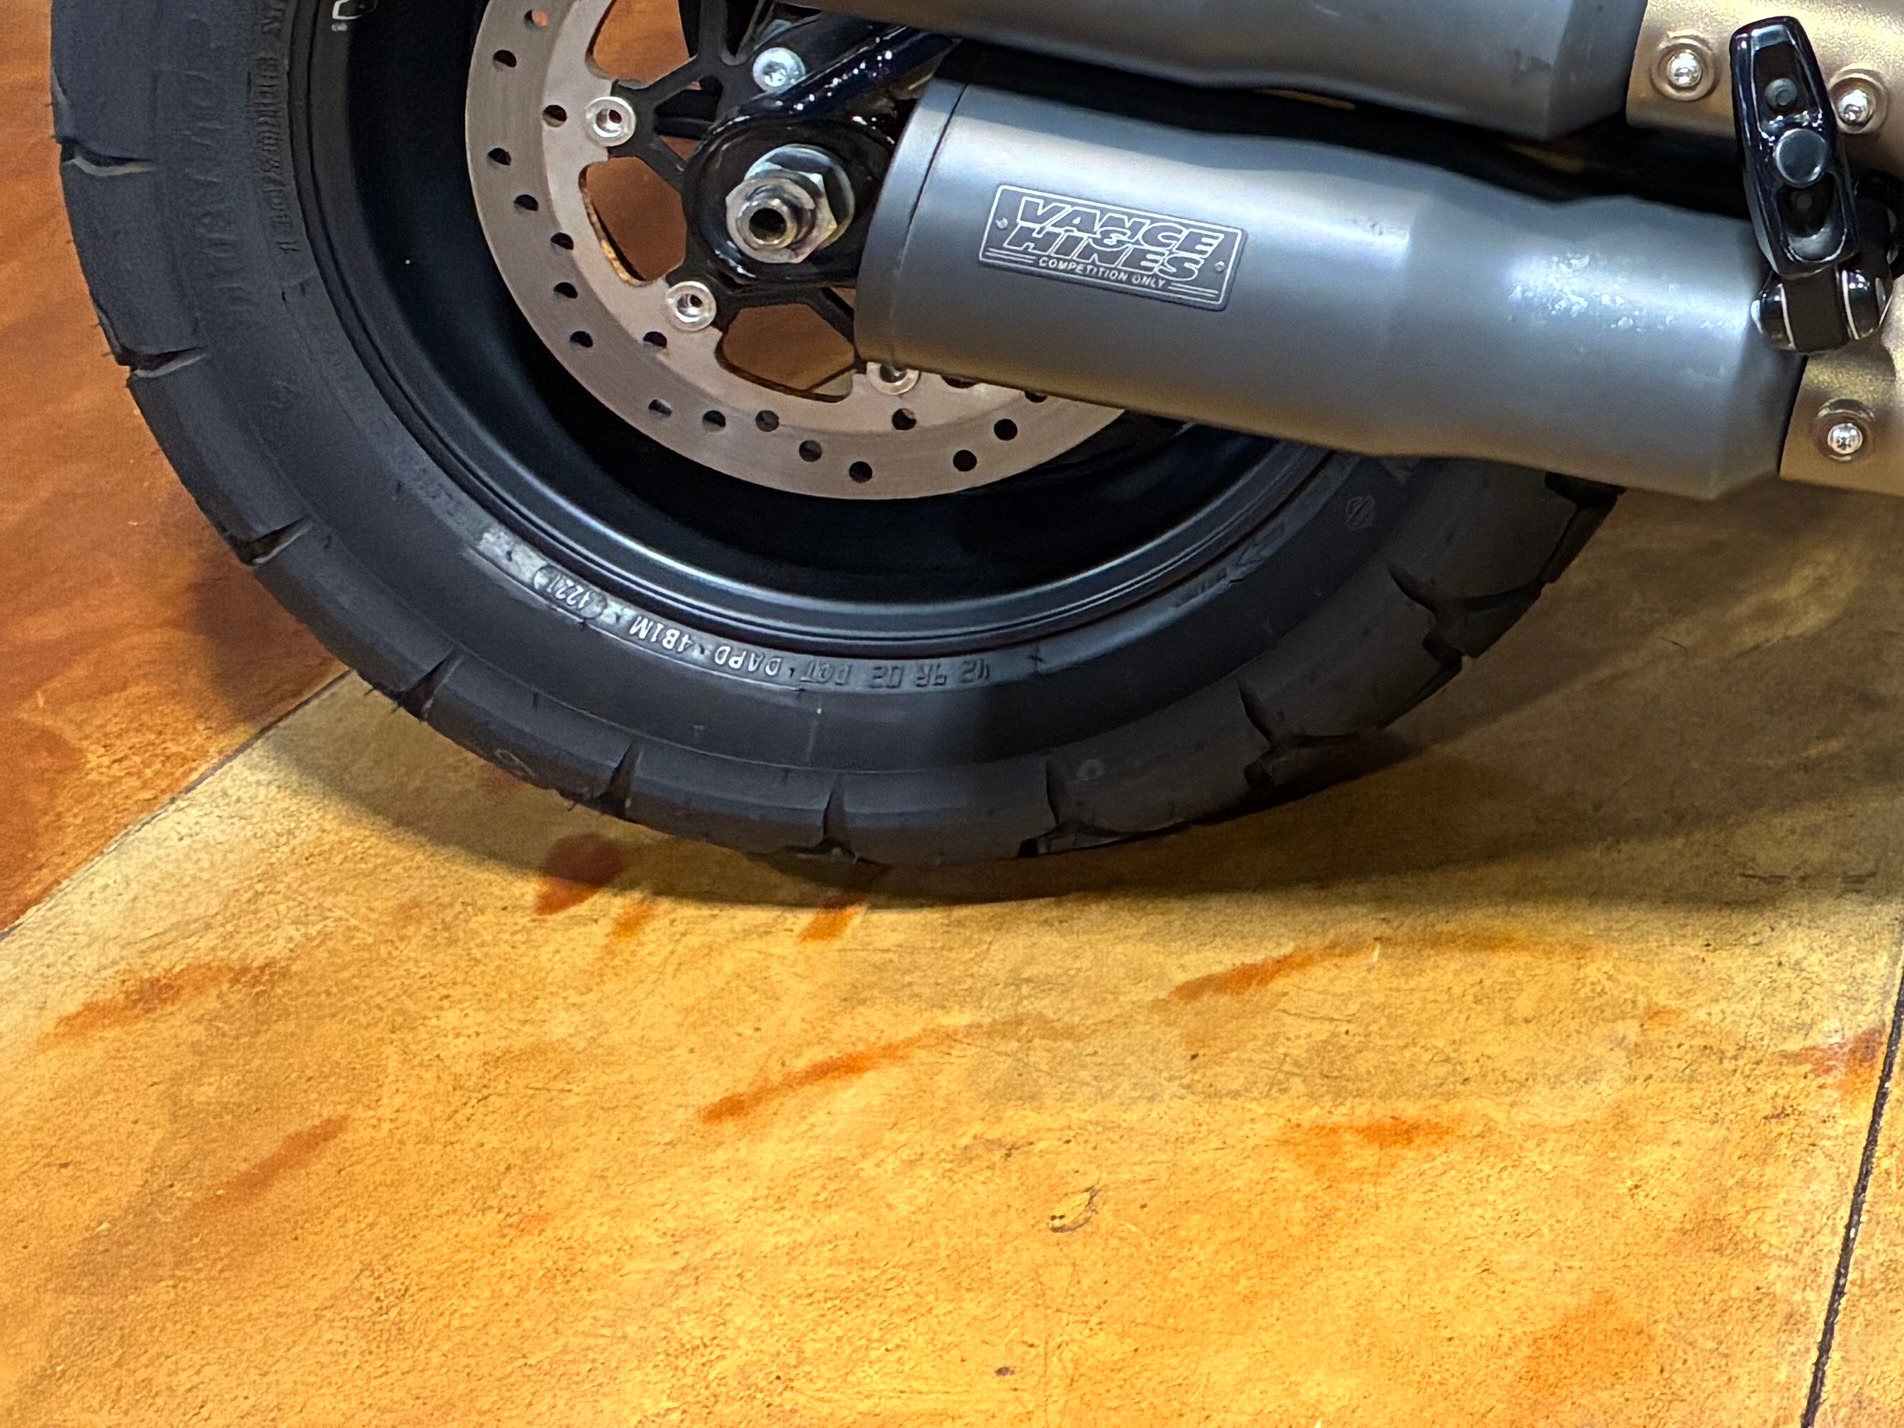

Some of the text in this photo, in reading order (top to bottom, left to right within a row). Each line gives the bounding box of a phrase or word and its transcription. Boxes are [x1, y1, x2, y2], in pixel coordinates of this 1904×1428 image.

[1003, 223, 1204, 281] HINES
[1017, 197, 1224, 257] VANCE
[1039, 257, 1166, 289] COMPETITION ONLY
